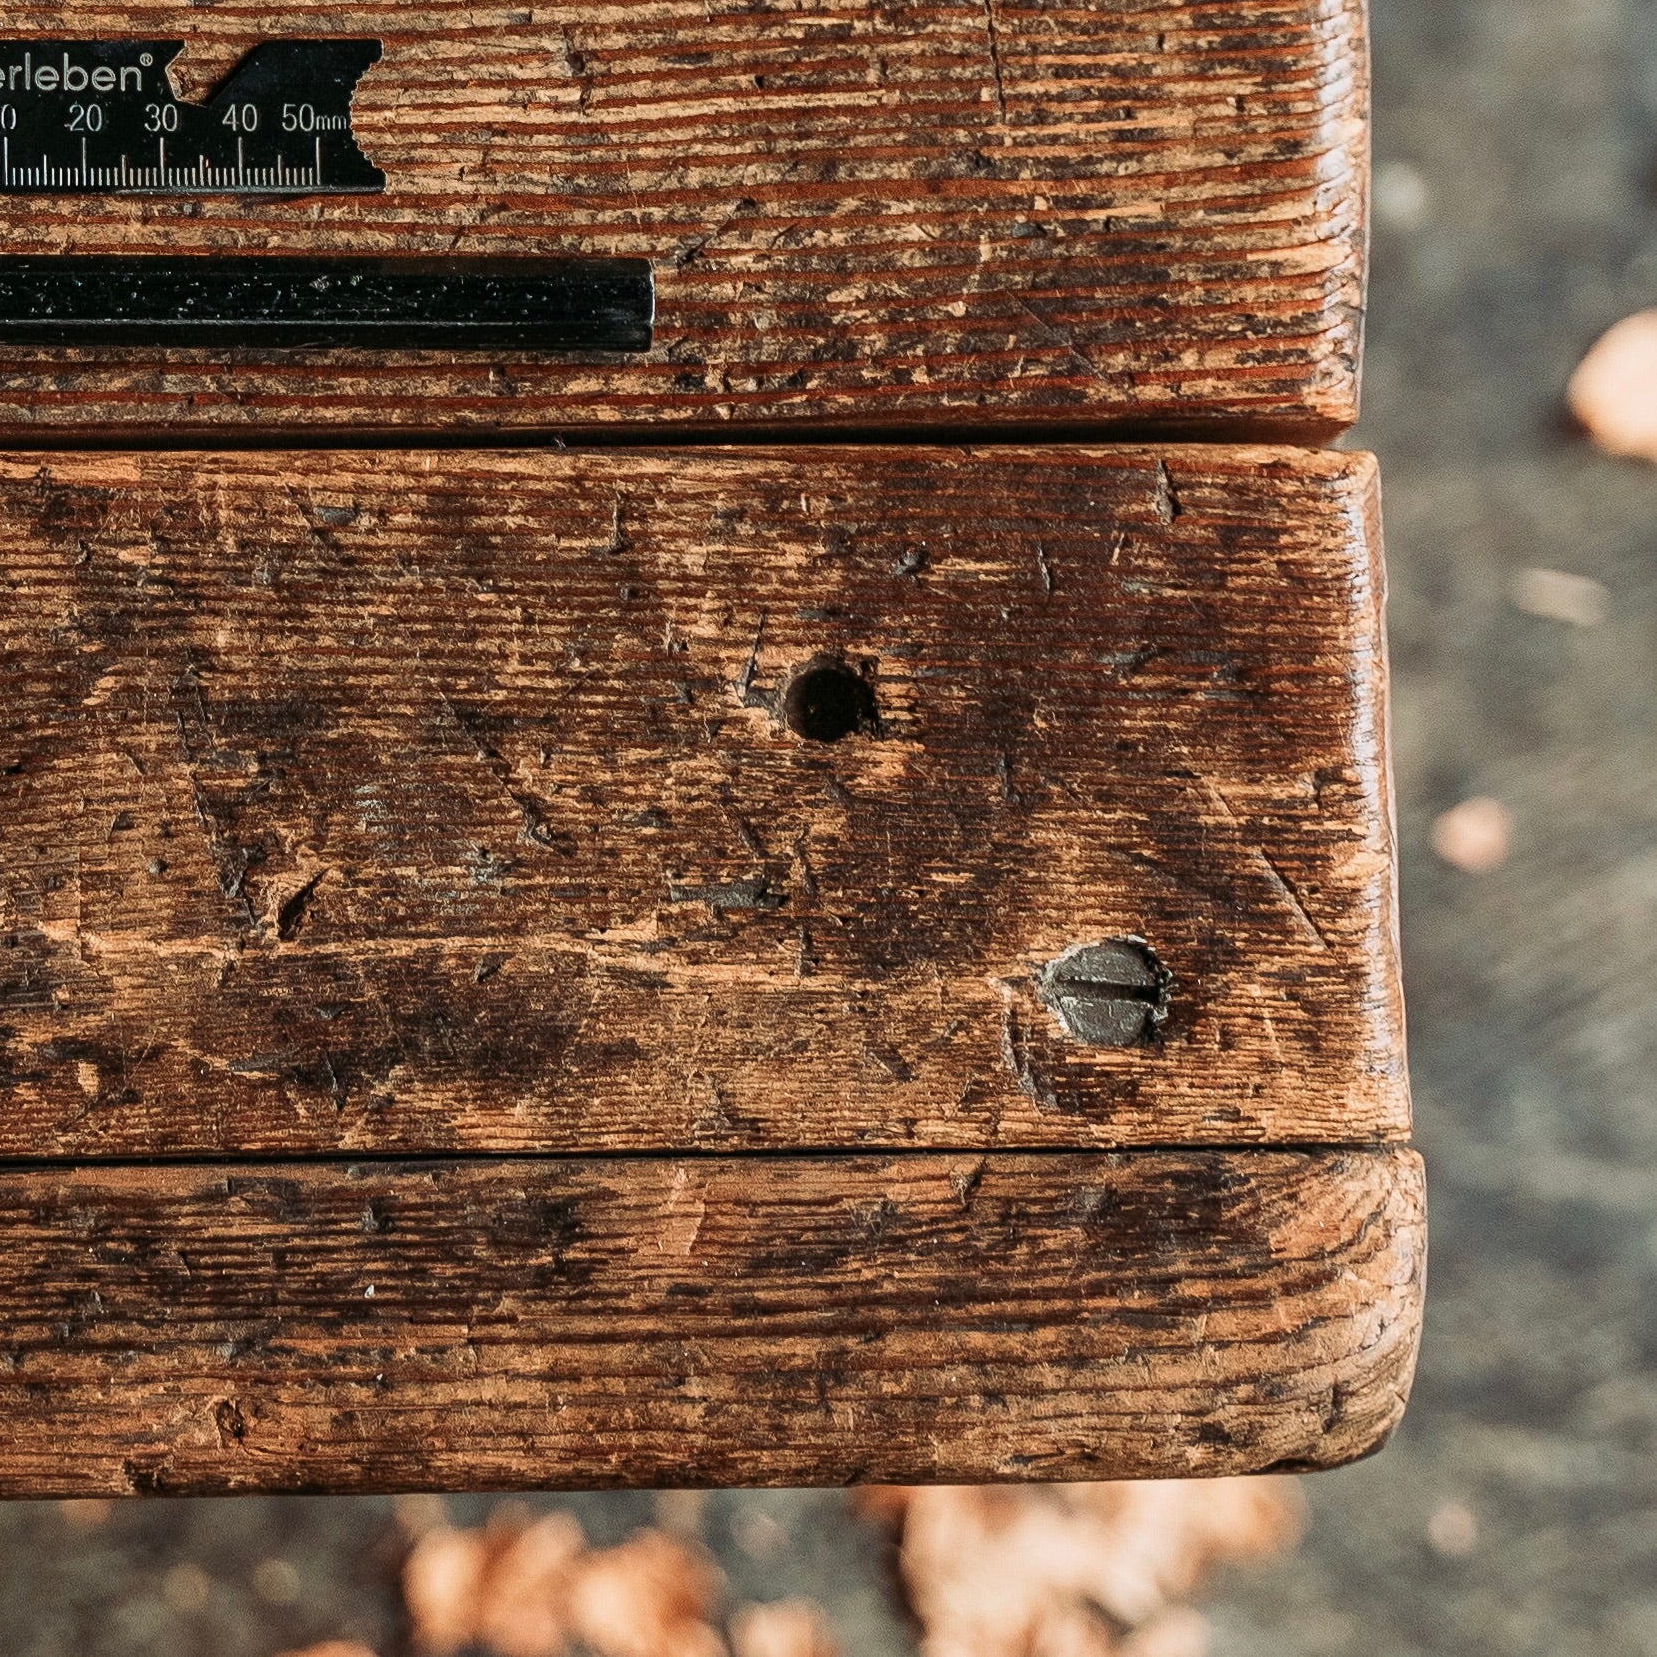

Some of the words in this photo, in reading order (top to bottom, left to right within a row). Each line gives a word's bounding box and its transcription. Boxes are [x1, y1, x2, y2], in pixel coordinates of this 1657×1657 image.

[69, 103, 102, 132] 20
[144, 103, 178, 132] 30
[222, 103, 258, 132] 40
